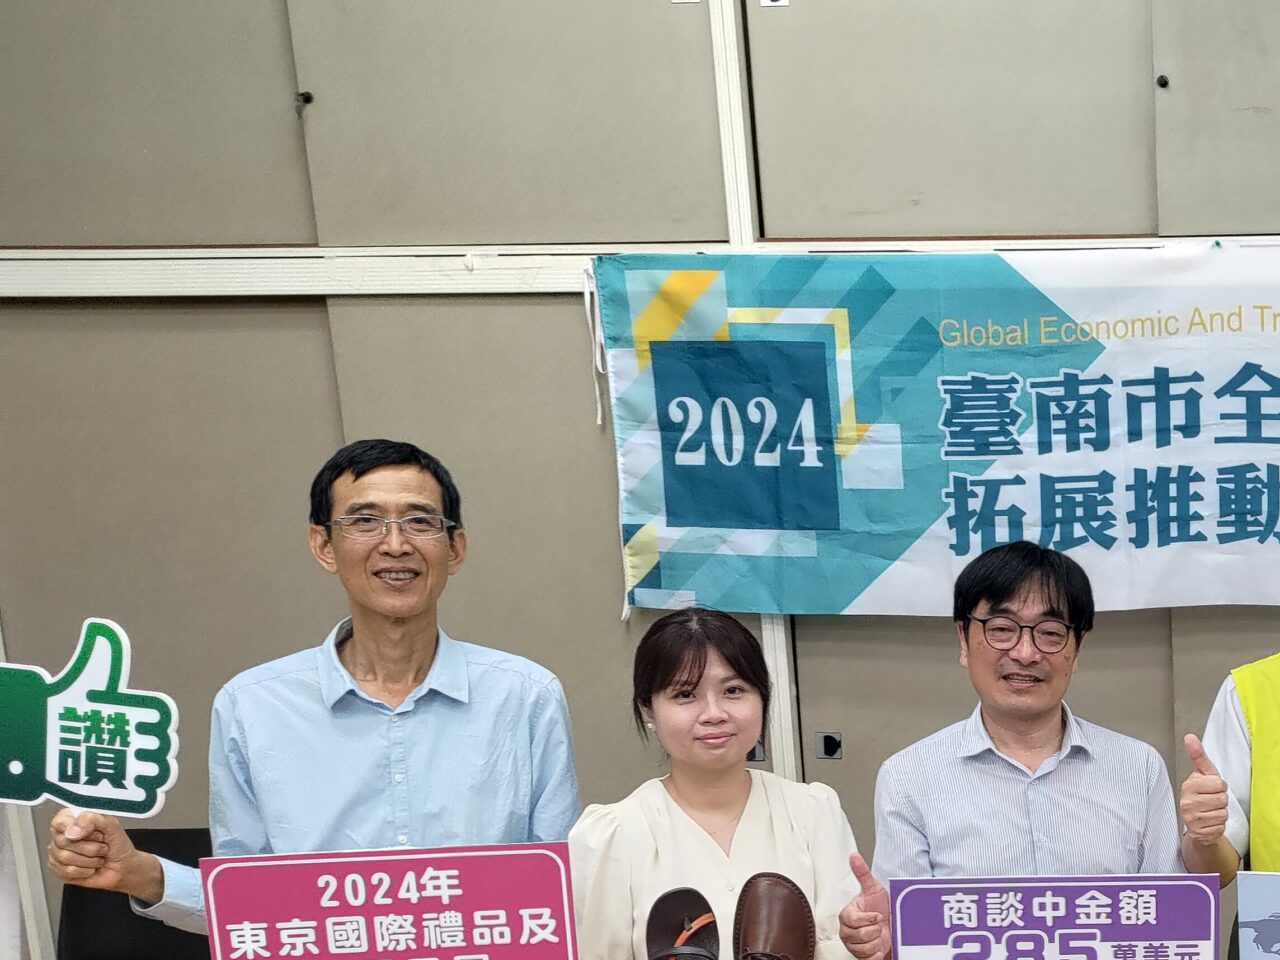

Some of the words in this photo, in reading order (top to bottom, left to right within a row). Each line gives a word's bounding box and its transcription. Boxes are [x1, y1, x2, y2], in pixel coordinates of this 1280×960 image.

[939, 318, 1029, 347] Global
[1040, 310, 1180, 345] Economic
[1188, 306, 1243, 334] And
[667, 395, 824, 468] 2024
[57, 706, 131, 790] 讚
[316, 866, 464, 908] 2024年
[940, 888, 1158, 929] 商談中金額
[225, 907, 560, 960] 東京國際禮品及
